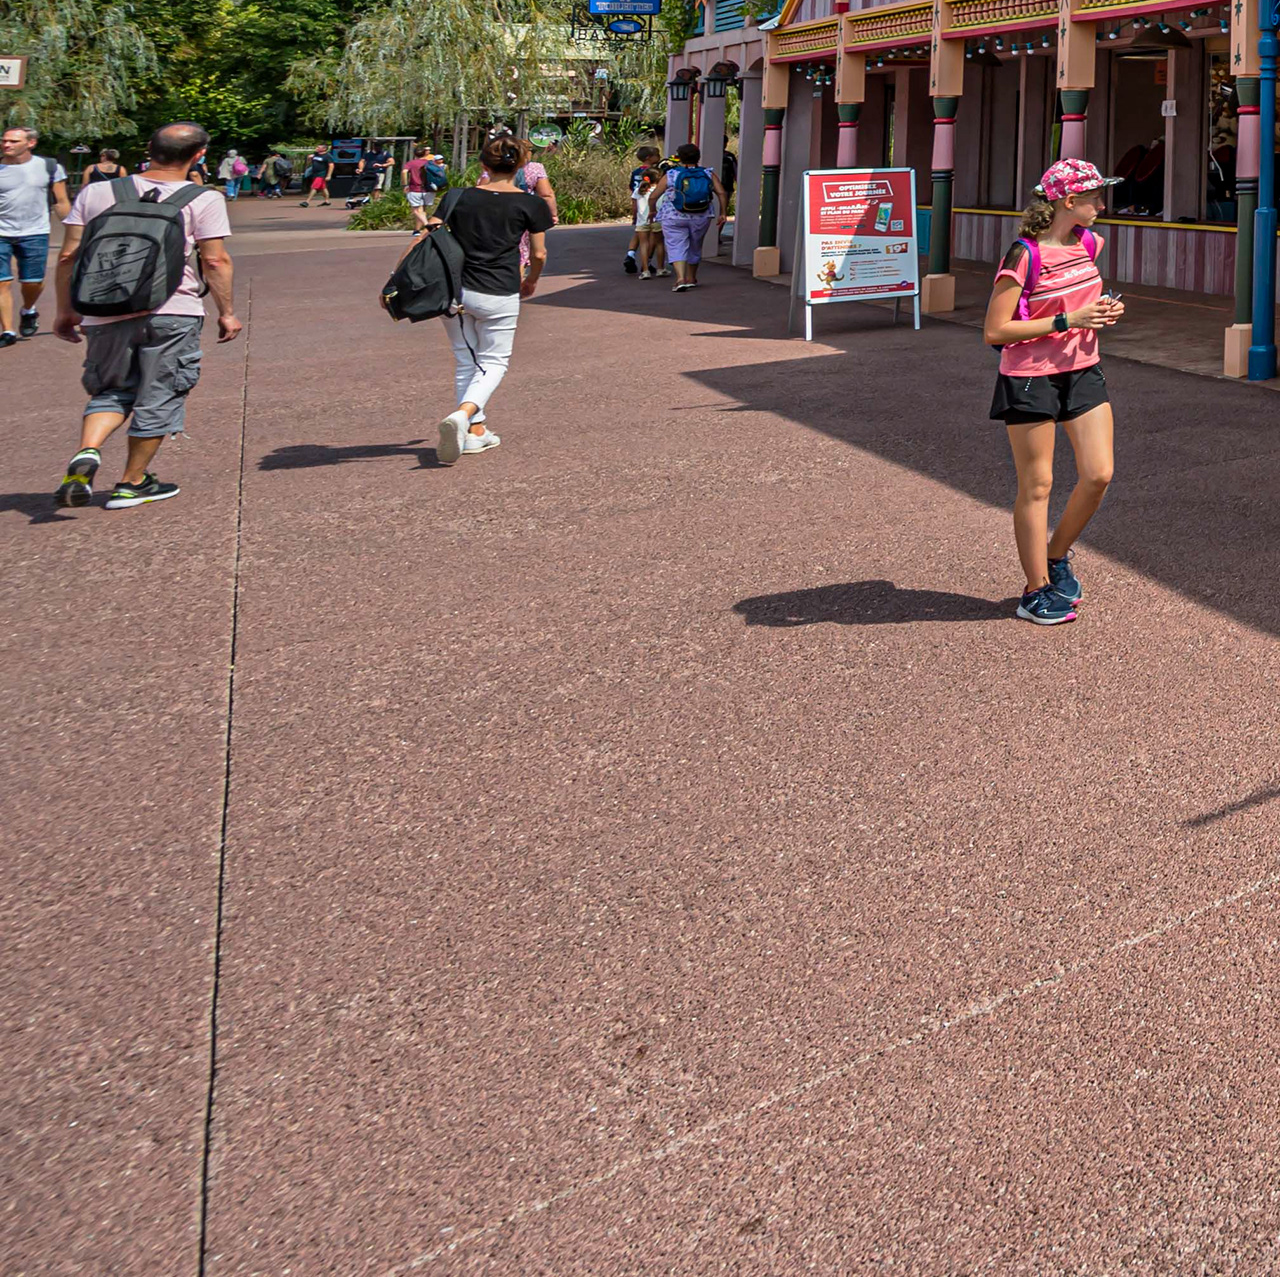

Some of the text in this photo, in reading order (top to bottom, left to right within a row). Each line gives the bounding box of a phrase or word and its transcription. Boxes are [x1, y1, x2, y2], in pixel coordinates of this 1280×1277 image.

[829, 187, 886, 198] VOTRE JOURNÉE
[838, 183, 878, 192] OPTIMISEZ
